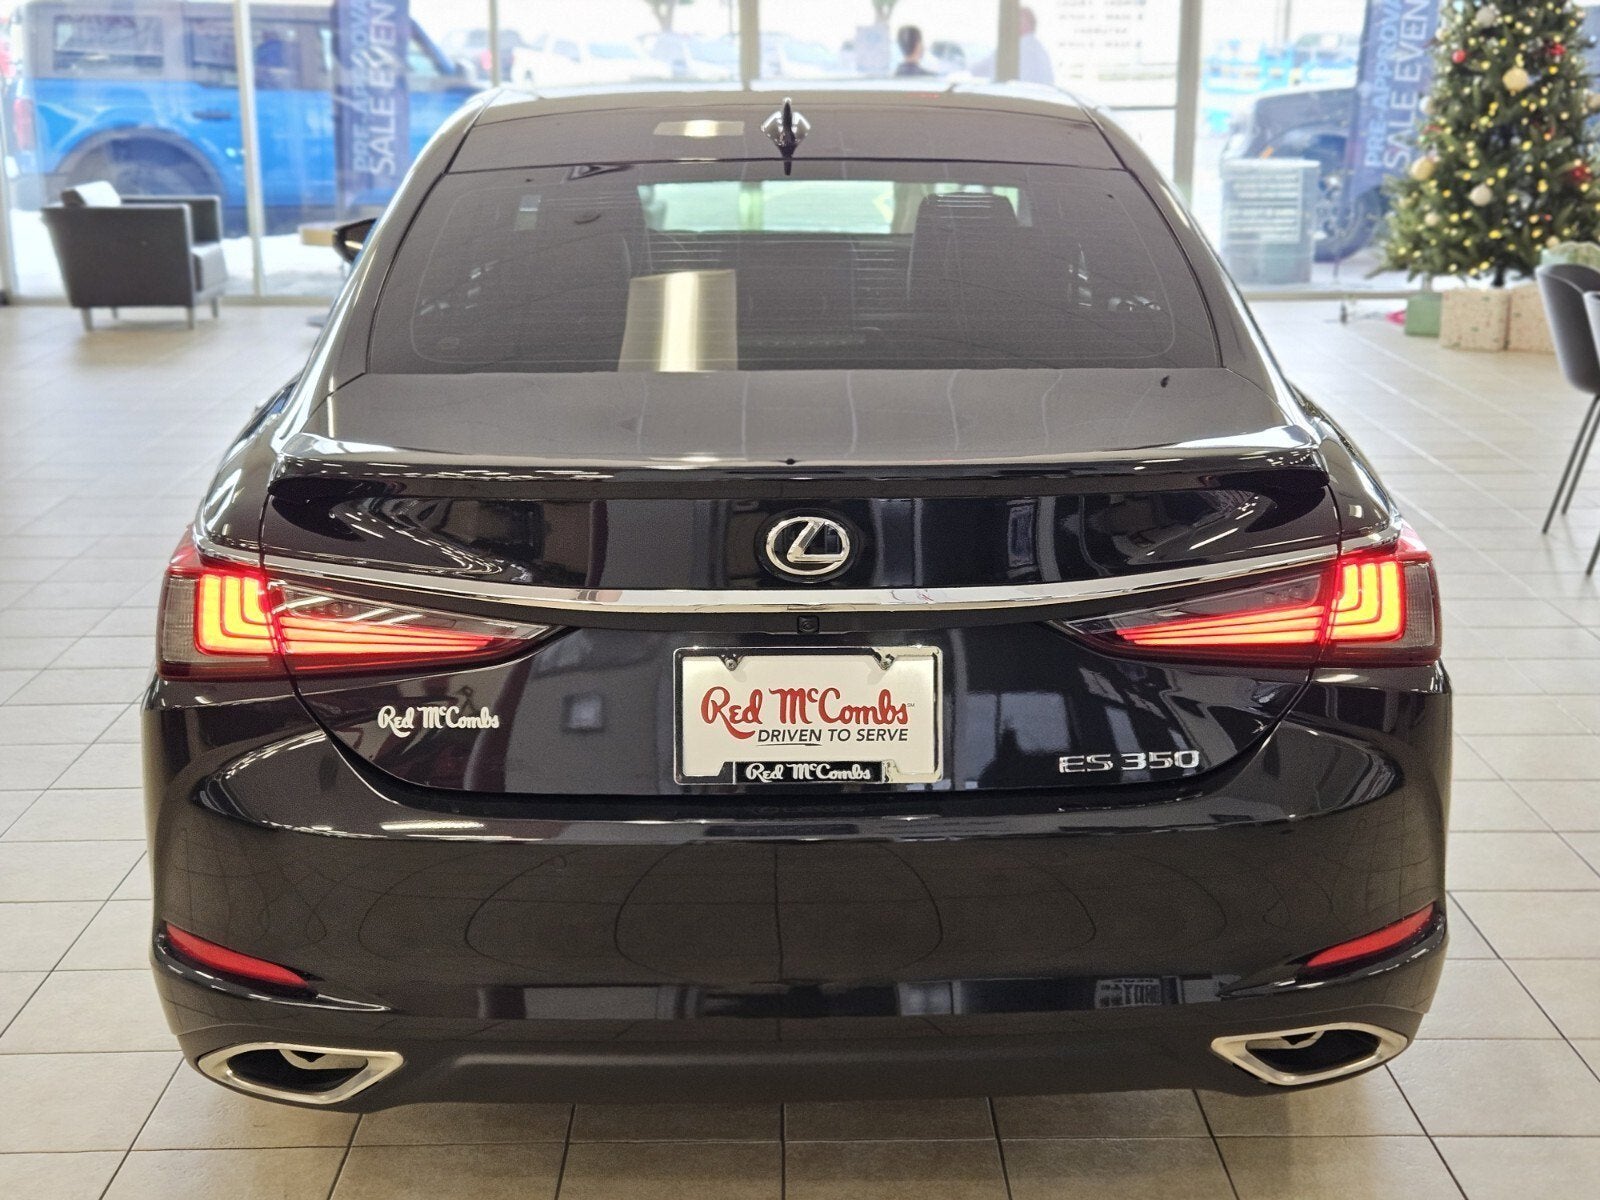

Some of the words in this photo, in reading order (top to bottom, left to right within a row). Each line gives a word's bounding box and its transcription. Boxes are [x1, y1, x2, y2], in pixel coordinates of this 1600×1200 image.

[369, 97, 397, 175] SALE
[1382, 90, 1418, 169] SALE
[377, 705, 415, 738] Red
[416, 705, 500, 729] McCombs
[701, 686, 763, 740] Red
[768, 687, 908, 725] McCombs
[757, 729, 822, 742] DRIVEN
[828, 728, 851, 742] TO
[856, 728, 909, 742] SERVE
[745, 762, 784, 783] Red
[786, 762, 871, 780] McCombs
[1058, 754, 1114, 773] ES
[1120, 750, 1200, 770] 350
